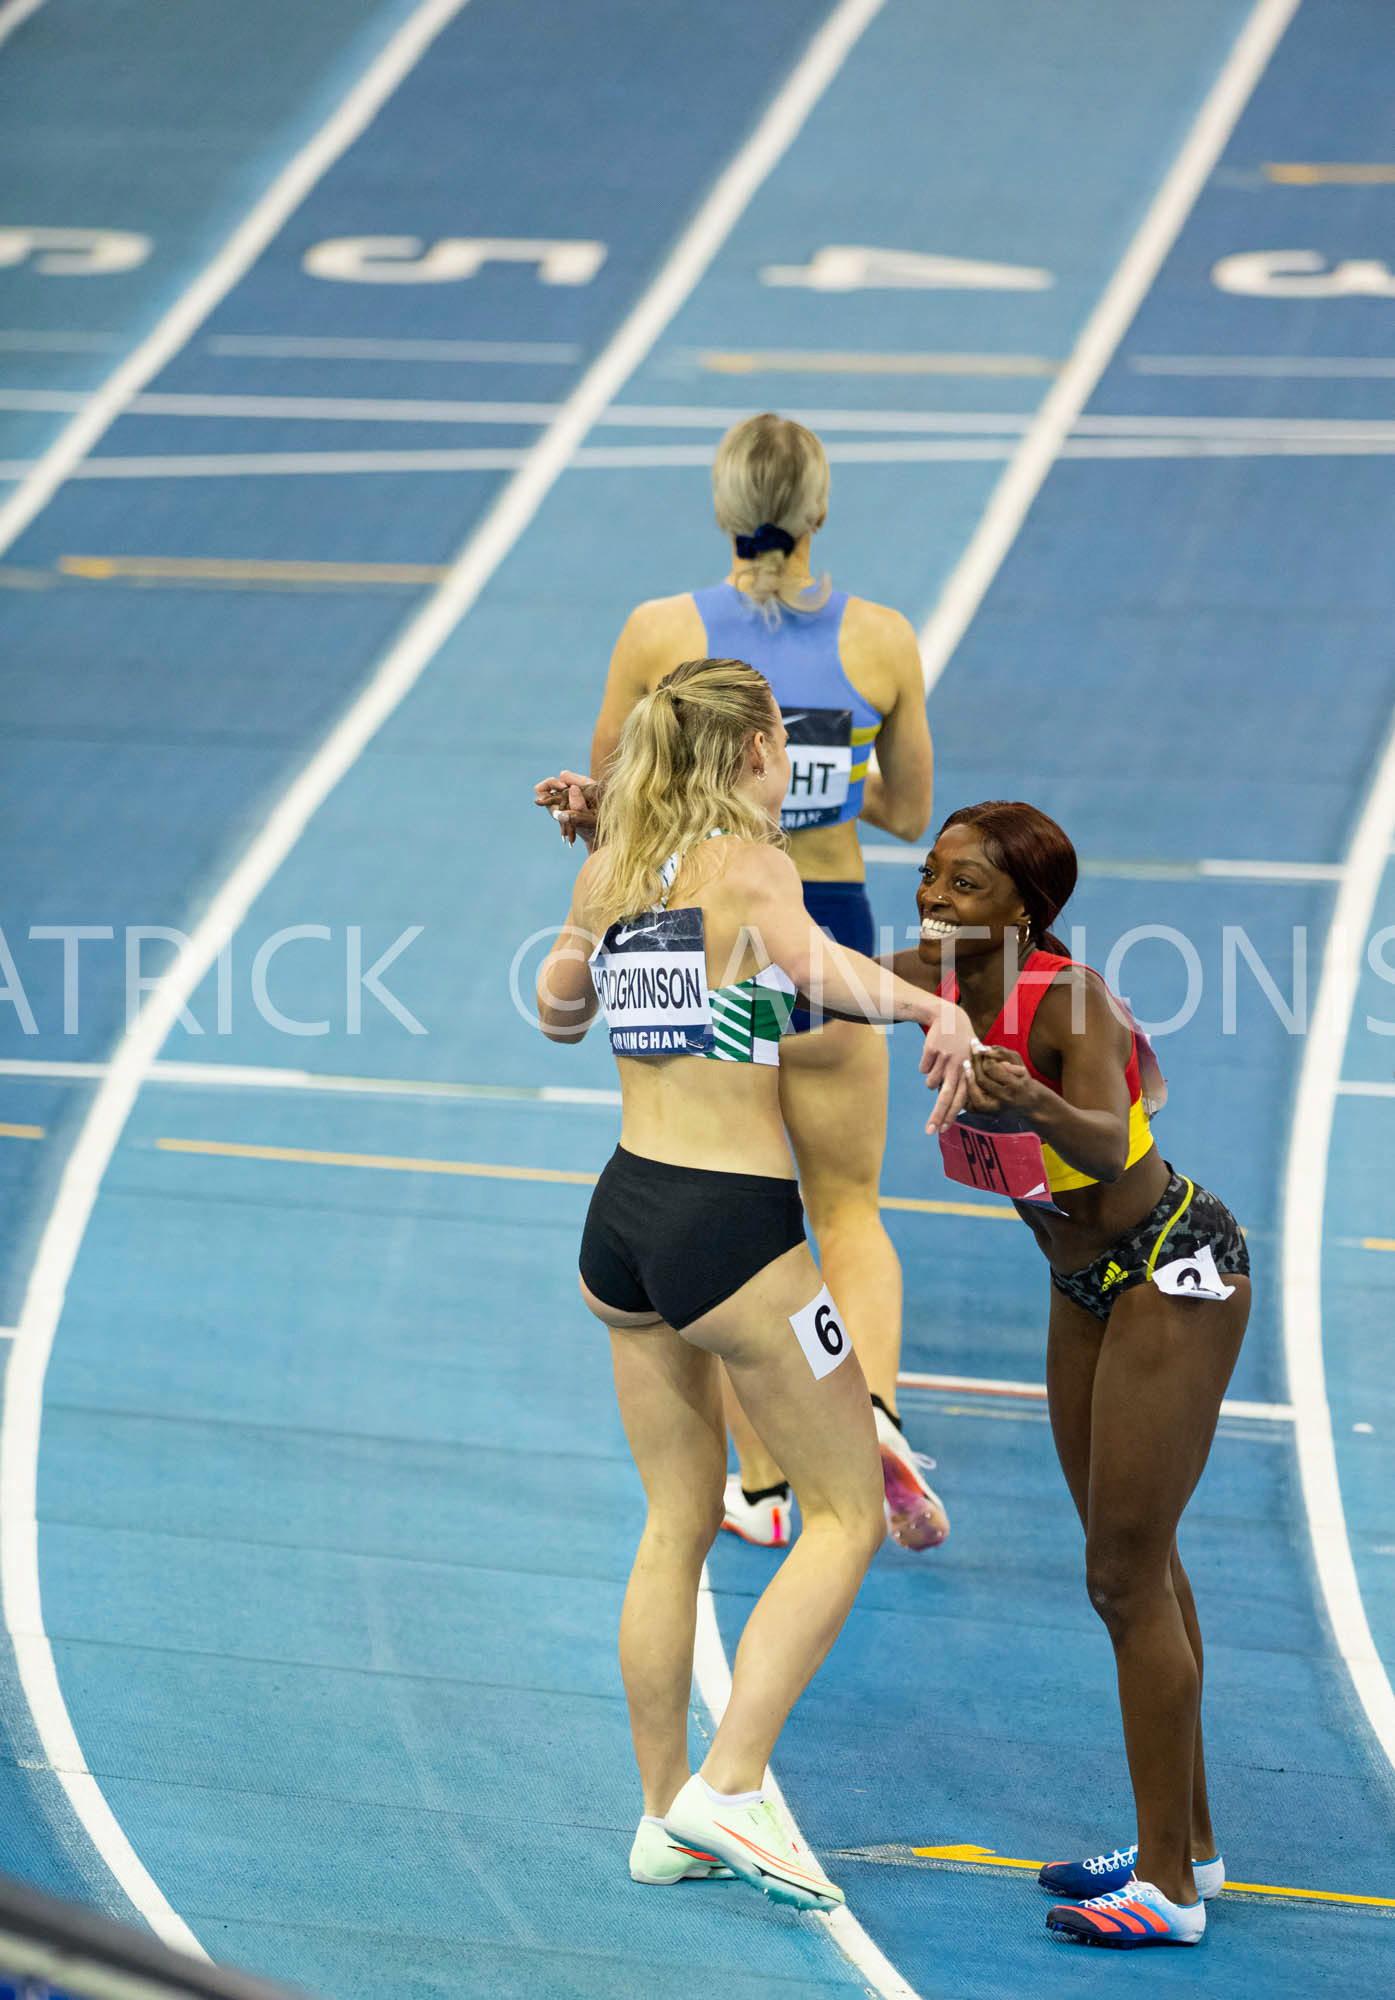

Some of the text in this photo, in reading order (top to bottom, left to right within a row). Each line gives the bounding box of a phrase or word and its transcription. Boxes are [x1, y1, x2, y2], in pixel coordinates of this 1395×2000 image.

[303, 235, 607, 287] 5
[960, 1127, 1010, 1193] PIPI
[814, 1304, 844, 1356] 6
